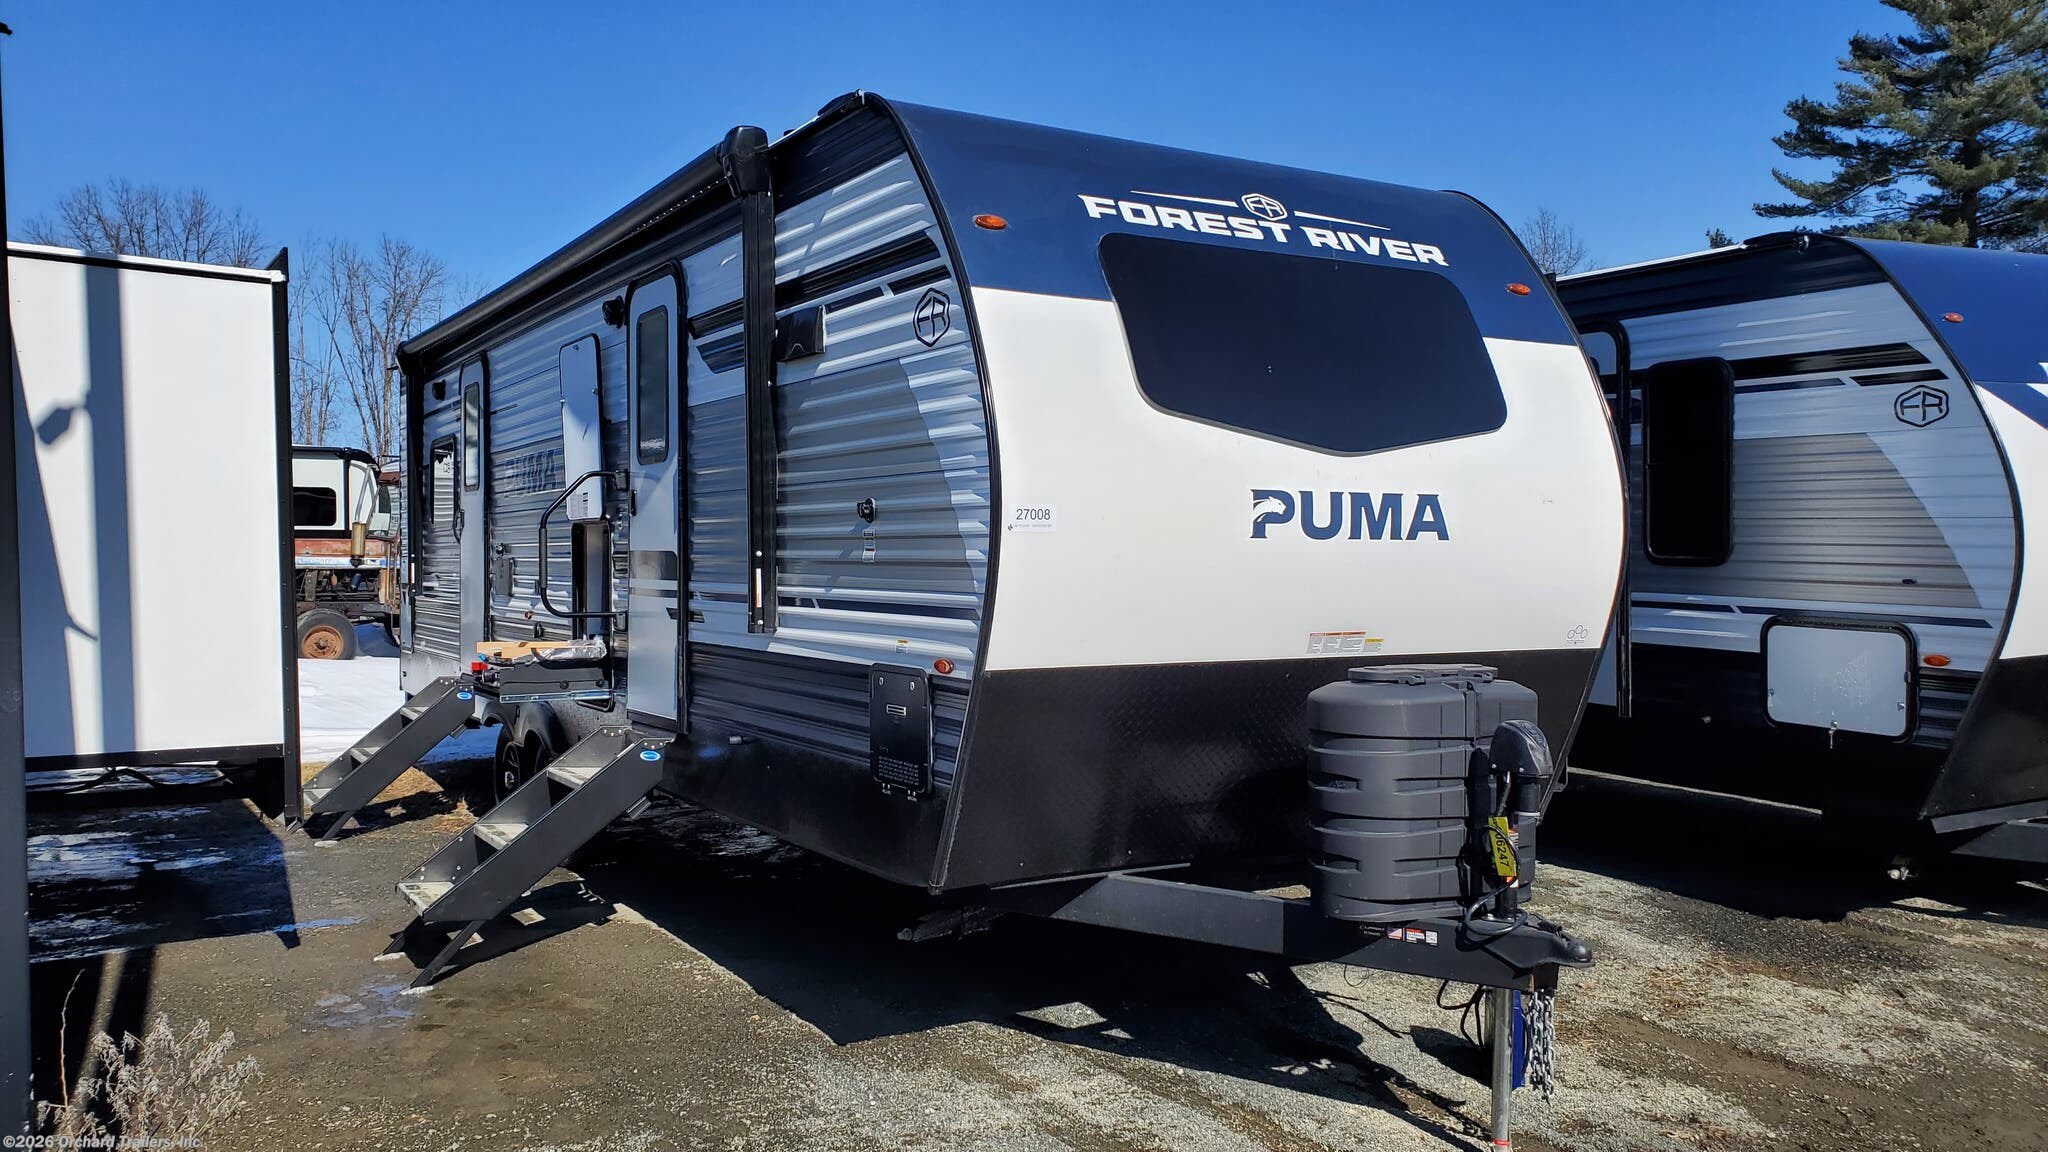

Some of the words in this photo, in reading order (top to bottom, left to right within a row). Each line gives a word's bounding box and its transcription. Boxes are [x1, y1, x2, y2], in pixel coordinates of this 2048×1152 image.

[1077, 194, 1291, 243] FOREST
[1299, 226, 1449, 266] RIVER
[1016, 508, 1051, 520] 27008
[1250, 489, 1450, 541] PUMA
